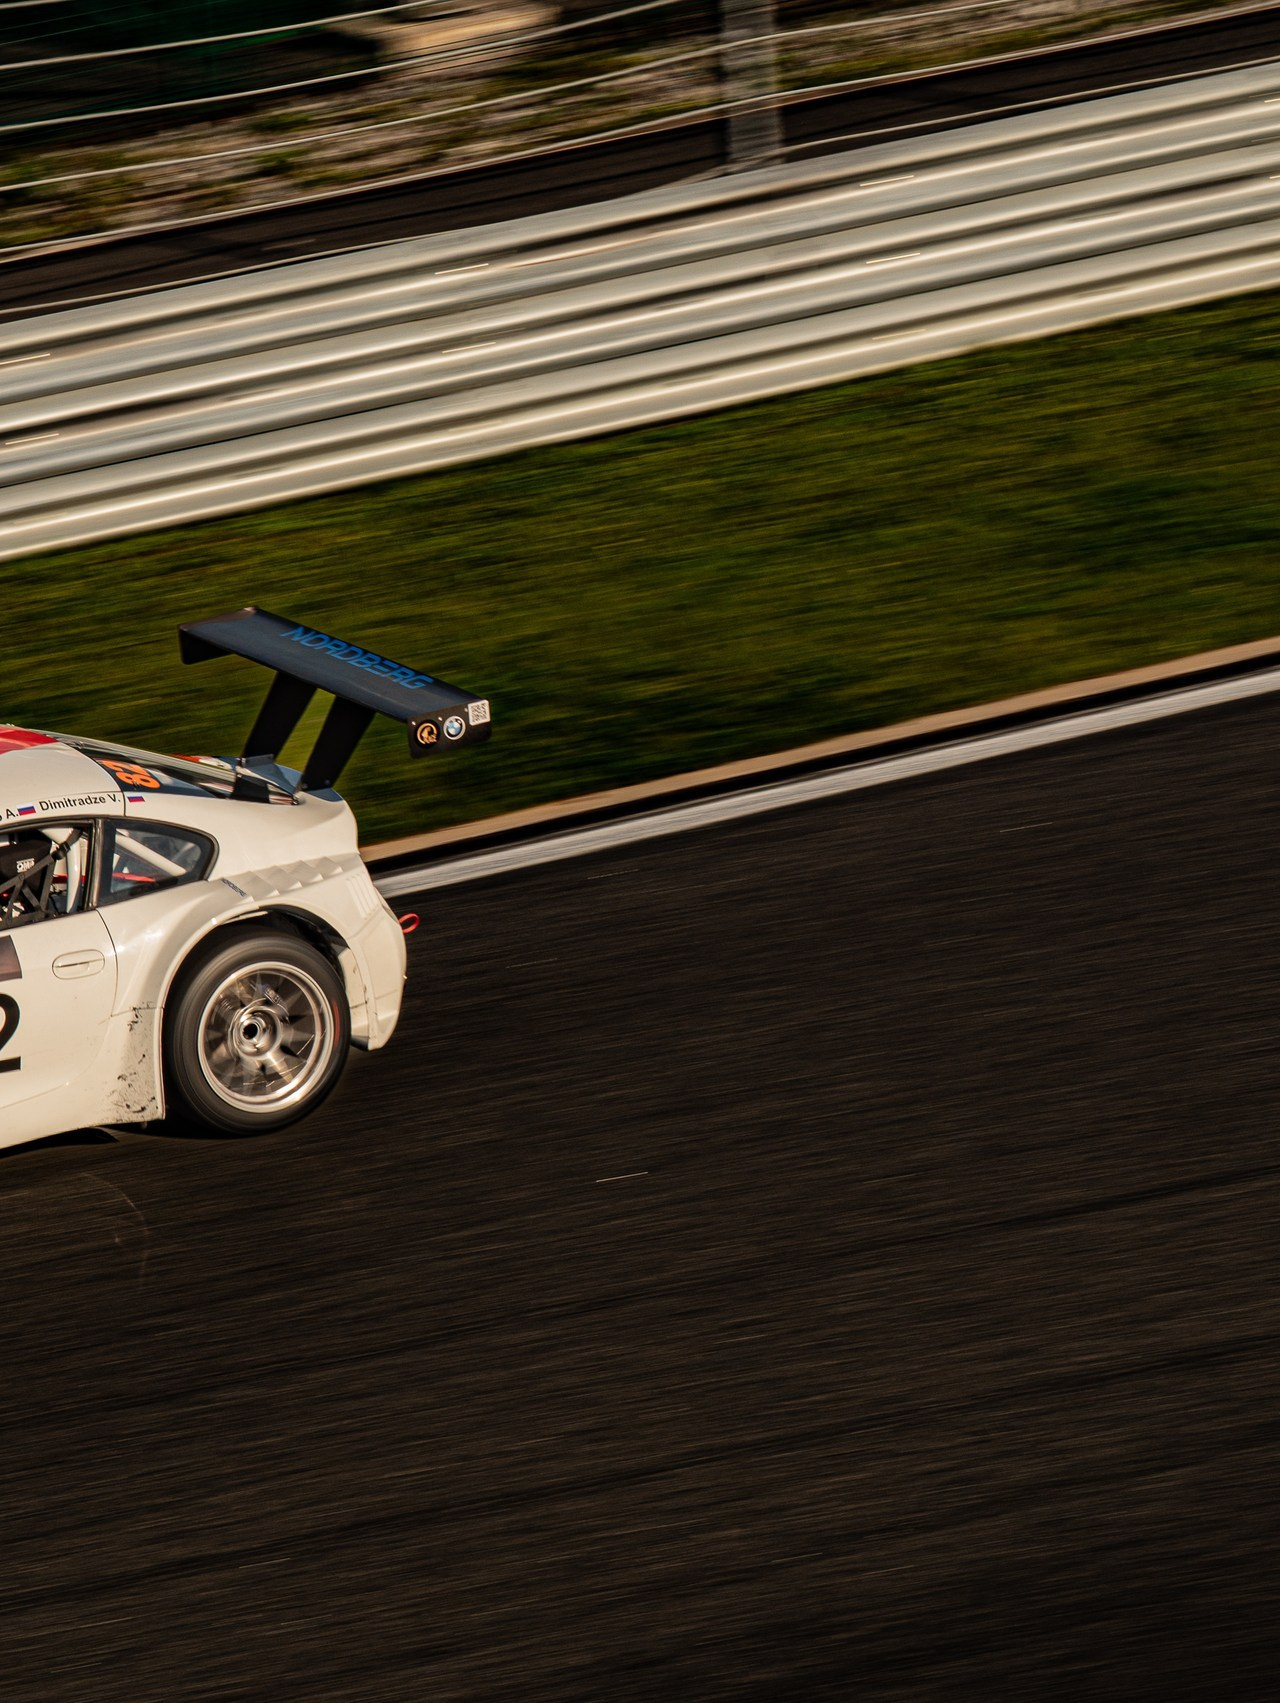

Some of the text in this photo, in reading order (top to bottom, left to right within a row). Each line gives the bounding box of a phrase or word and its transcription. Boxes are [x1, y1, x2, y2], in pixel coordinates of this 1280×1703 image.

[280, 626, 435, 689] NORDBERG
[39, 793, 121, 811] Dimitradze V.
[5, 808, 19, 819] A.
